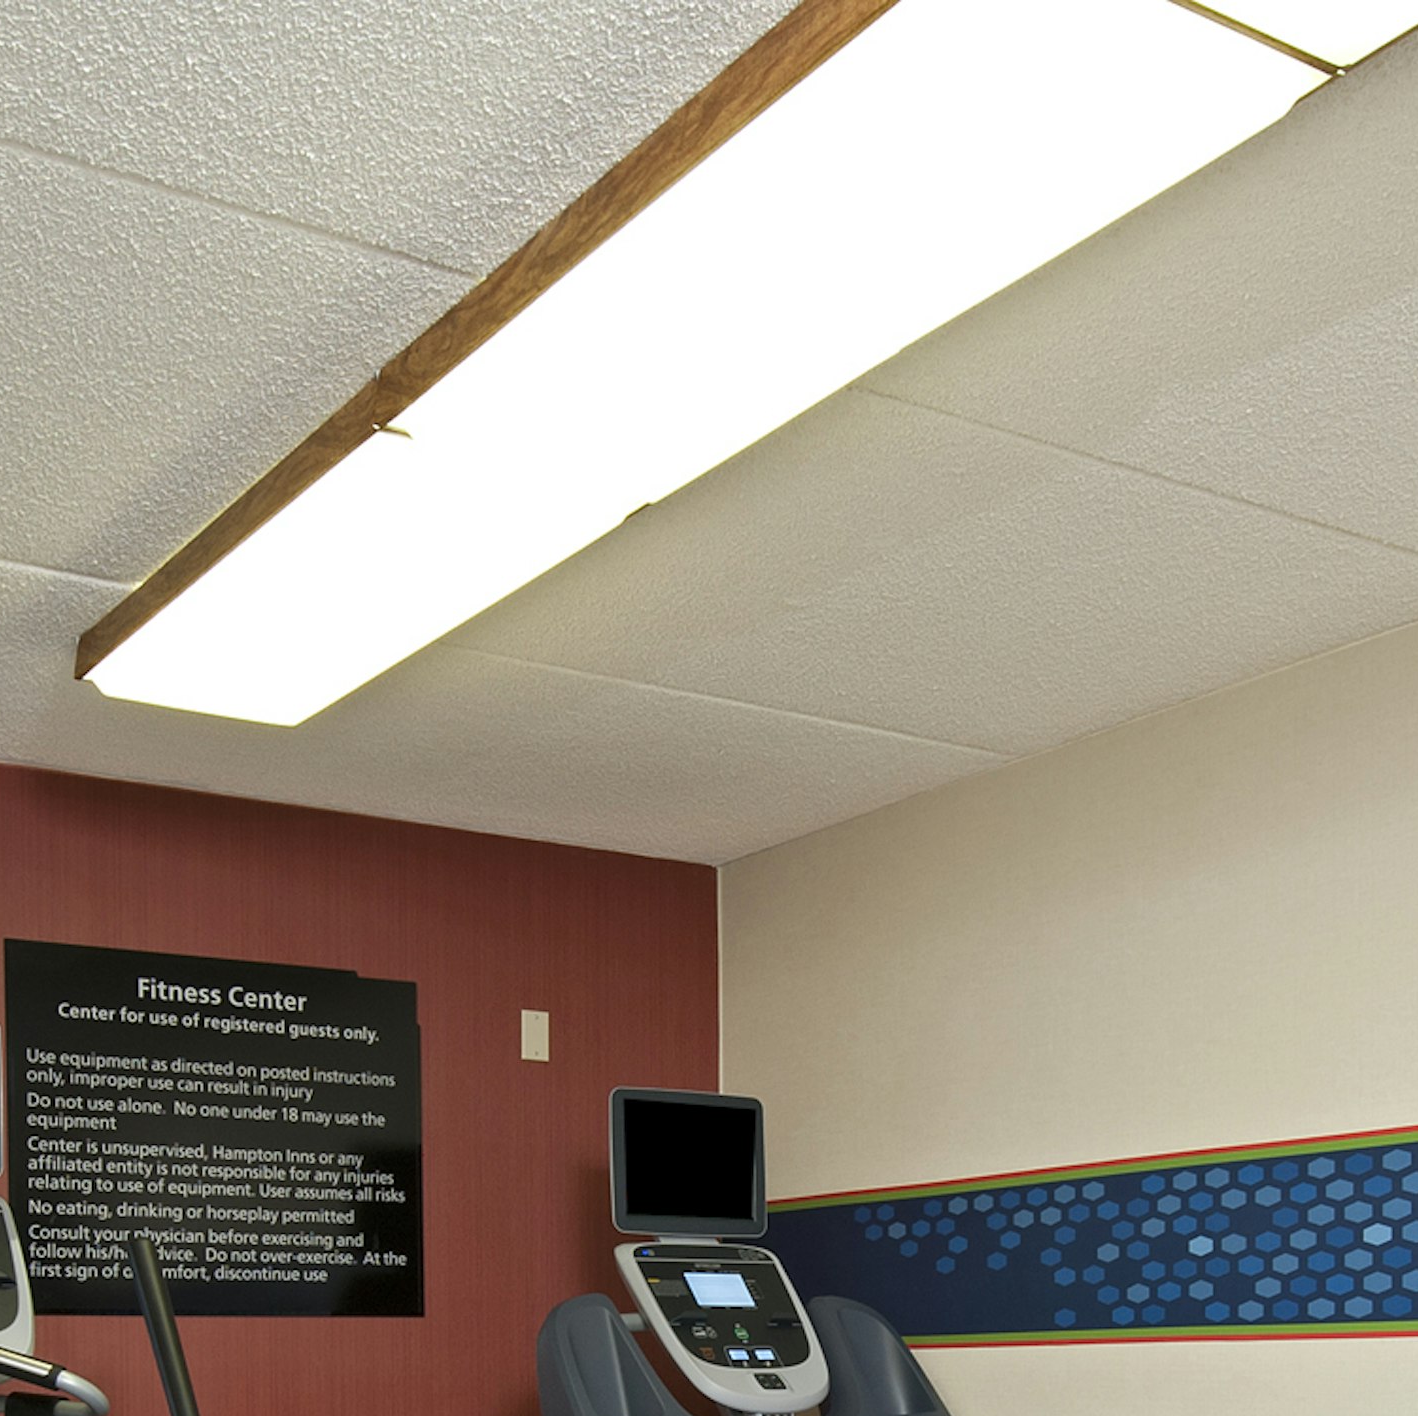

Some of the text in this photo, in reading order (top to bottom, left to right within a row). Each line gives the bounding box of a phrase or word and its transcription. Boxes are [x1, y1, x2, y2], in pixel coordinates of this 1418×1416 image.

[137, 977, 308, 1012] Fitness Center
[58, 1001, 379, 1045] Center for use of registered guests only.
[26, 1047, 396, 1087] Use equipment as directed on posted instructions
[26, 1067, 314, 1103] only, improper use can result in injury
[26, 1091, 386, 1127] Do not use alone. No one under 18 may use the
[26, 1113, 117, 1132] equipment
[27, 1135, 364, 1170] Center is unsupervised, Hampton Inns or any
[27, 1154, 395, 1187] affiliated entity is not responsible for any injuries
[28, 1173, 406, 1204] relating to use of equipment. User assumes all risks
[28, 1199, 355, 1225] No eating, drinking or horseplay permitted
[28, 1224, 90, 1241] Consult
[93, 1229, 131, 1245] your
[208, 1228, 259, 1245] before
[261, 1233, 334, 1250] exercising
[336, 1232, 365, 1248] and
[30, 1242, 408, 1267] follow his/h dvice. Do not over-exercise. At the
[30, 1262, 329, 1283] first sign of dmfort, discontinue use
